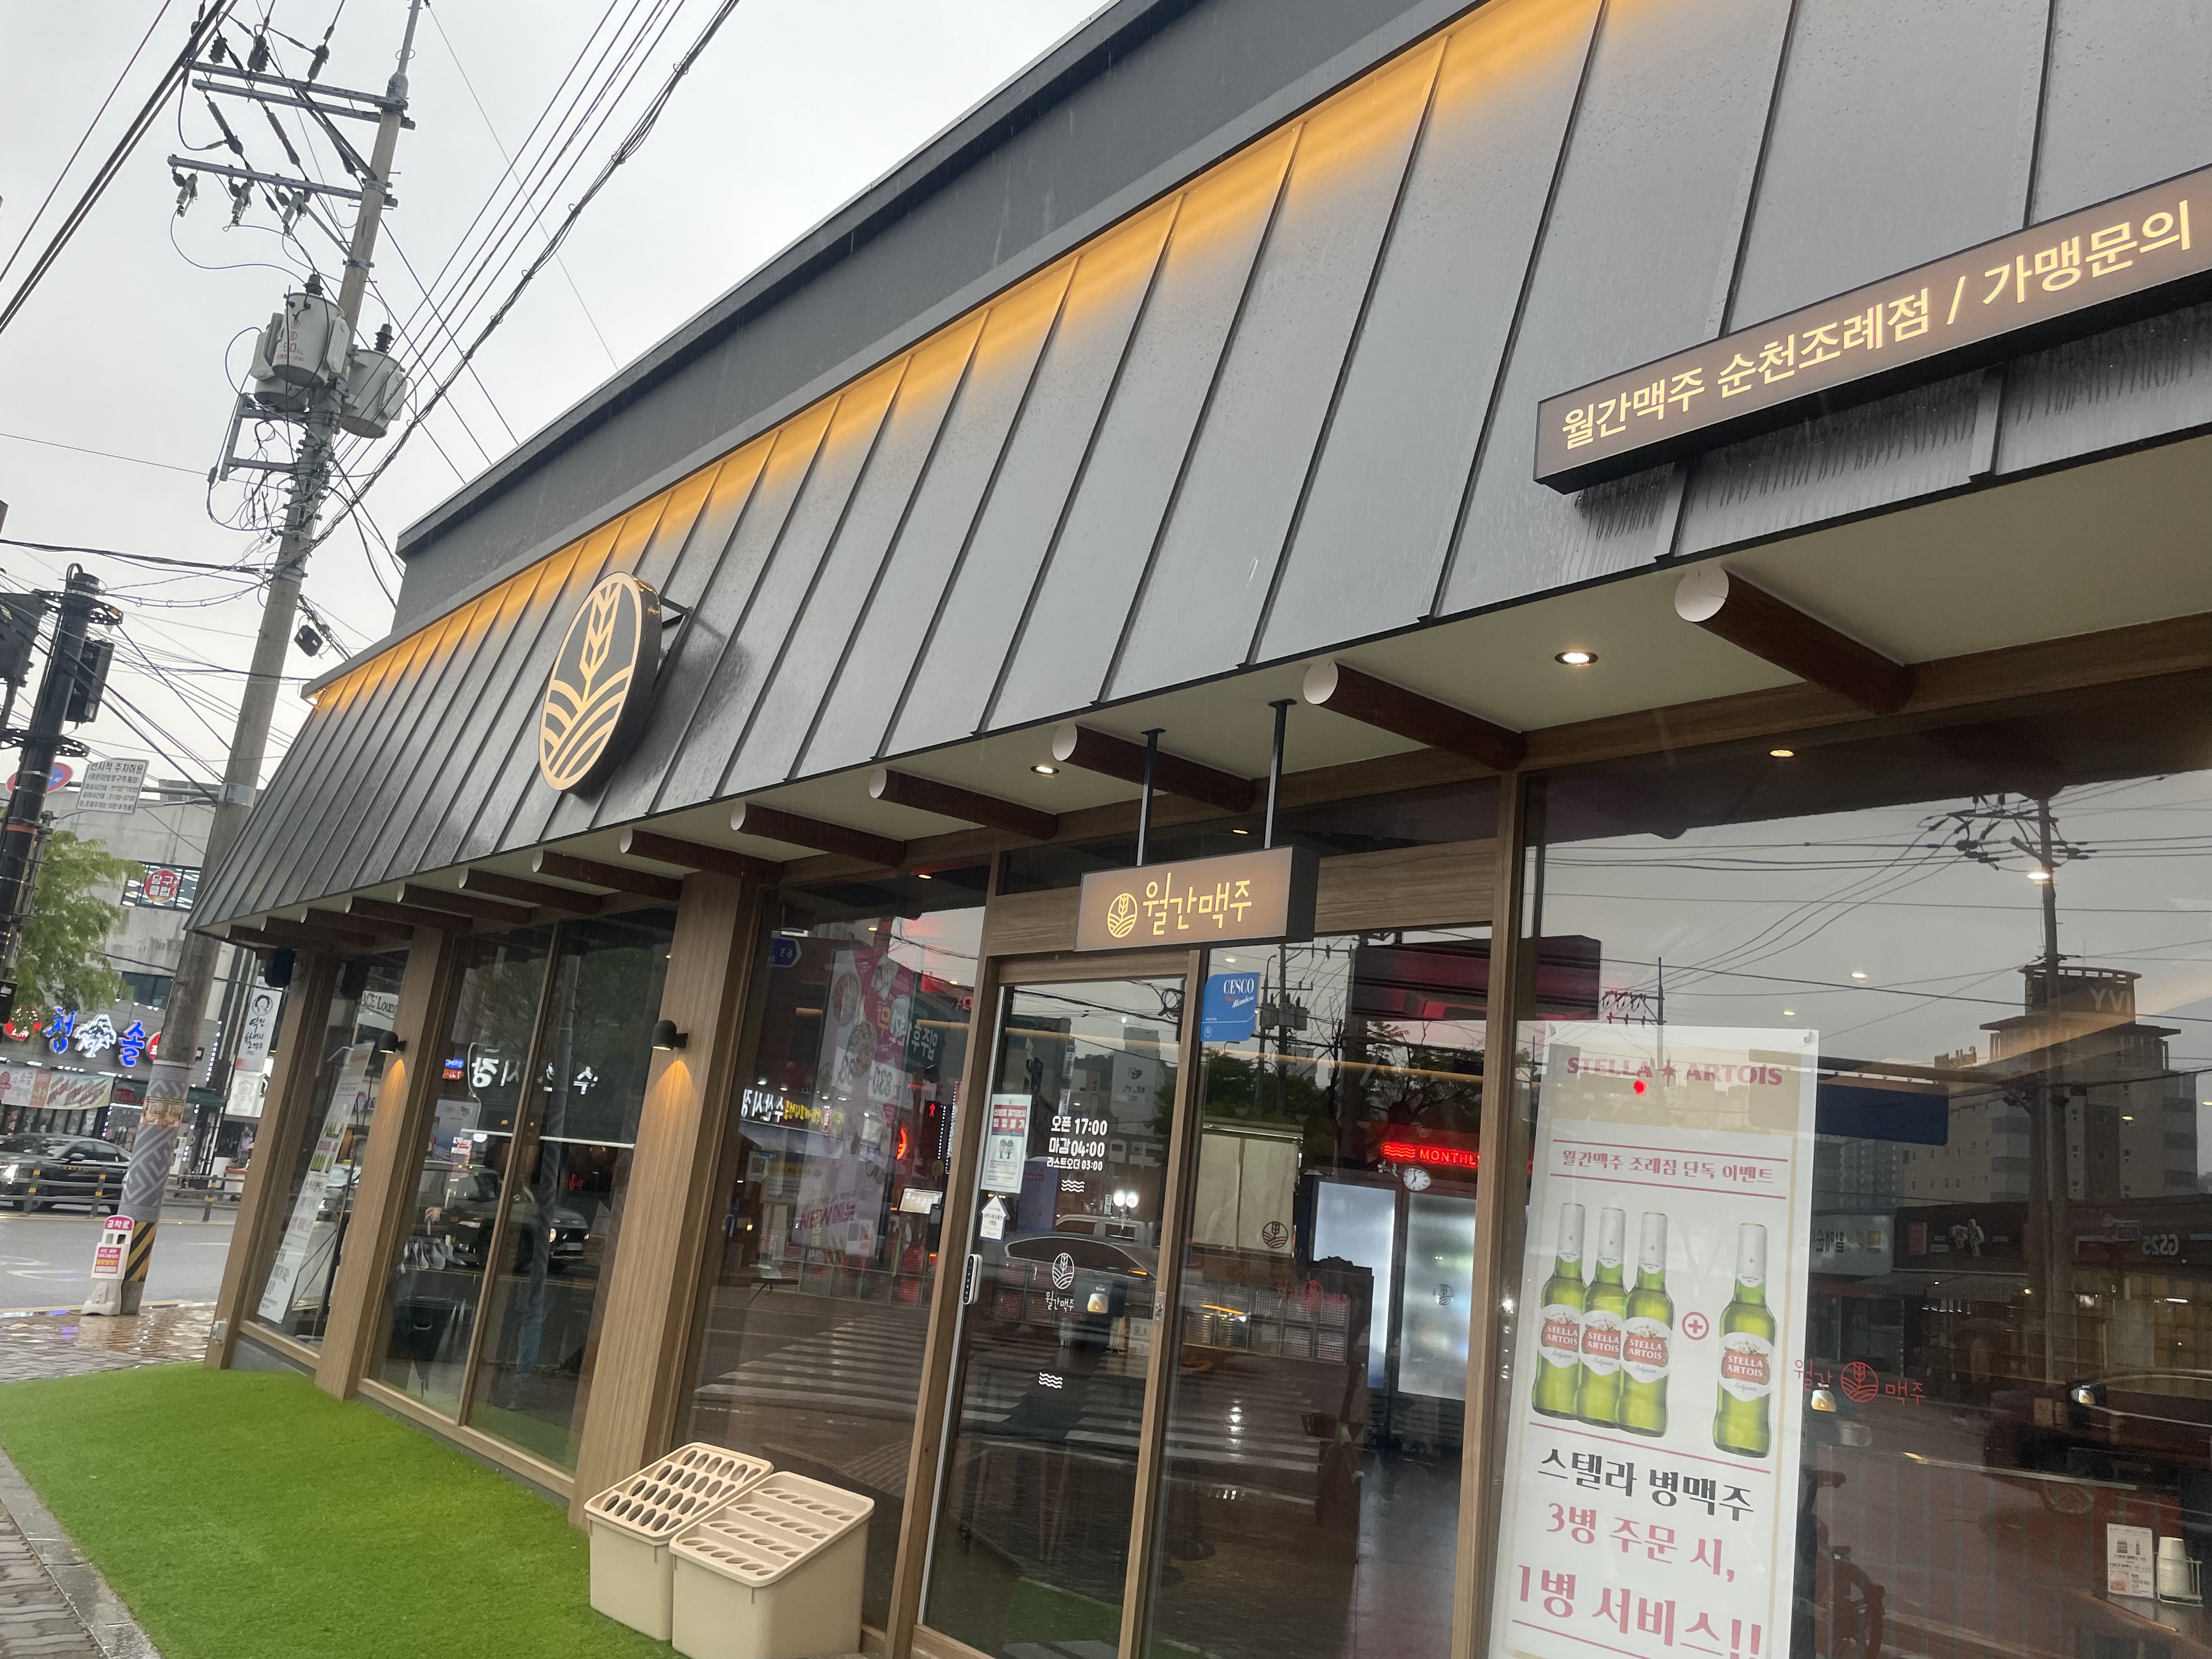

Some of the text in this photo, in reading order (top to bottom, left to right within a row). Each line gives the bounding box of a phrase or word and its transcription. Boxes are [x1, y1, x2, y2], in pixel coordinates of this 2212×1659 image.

[1561, 199, 2193, 451] 월간맥주 순천조례점 / 가맹문의
[114, 763, 144, 775] 주차허용
[151, 874, 174, 885] 당구
[1142, 872, 1252, 935] 월간맥주
[1223, 978, 1255, 995] CESCO
[1231, 995, 1255, 1009] Members
[120, 1019, 145, 1068] 솔
[1567, 1057, 1783, 1086] STELLA ARTOIS
[1051, 1115, 1108, 1136] 오픈 17:00
[1048, 1137, 1105, 1158] 마감 04:00
[1046, 1156, 1103, 1171] 라스트오더 03:00
[1419, 1147, 1481, 1166] MONTHL
[1562, 1150, 1624, 1170] 월간맥주
[1684, 1161, 1717, 1179] 단독
[1722, 1164, 1775, 1183] 이벤트
[107, 1220, 130, 1229] 교차로
[1045, 1290, 1074, 1313] 월간맥주
[1546, 1333, 1578, 1346] ARTOIS
[1547, 1325, 1578, 1337] STELLA
[1588, 1331, 1620, 1344] STELLA
[1587, 1340, 1620, 1353] ARTOIS
[1628, 1347, 1662, 1360] ARTOIS
[1629, 1339, 1662, 1352] STELLA
[1728, 1355, 1763, 1368] STELLA
[1726, 1364, 1763, 1378] ARTOIS
[1884, 1379, 1926, 1406] 맥주
[1537, 1448, 1754, 1522] 스텔라 병맥주
[1545, 1502, 1736, 1583] 3병 주문 시,
[1517, 1564, 1762, 1659] 1병 서비스!!
